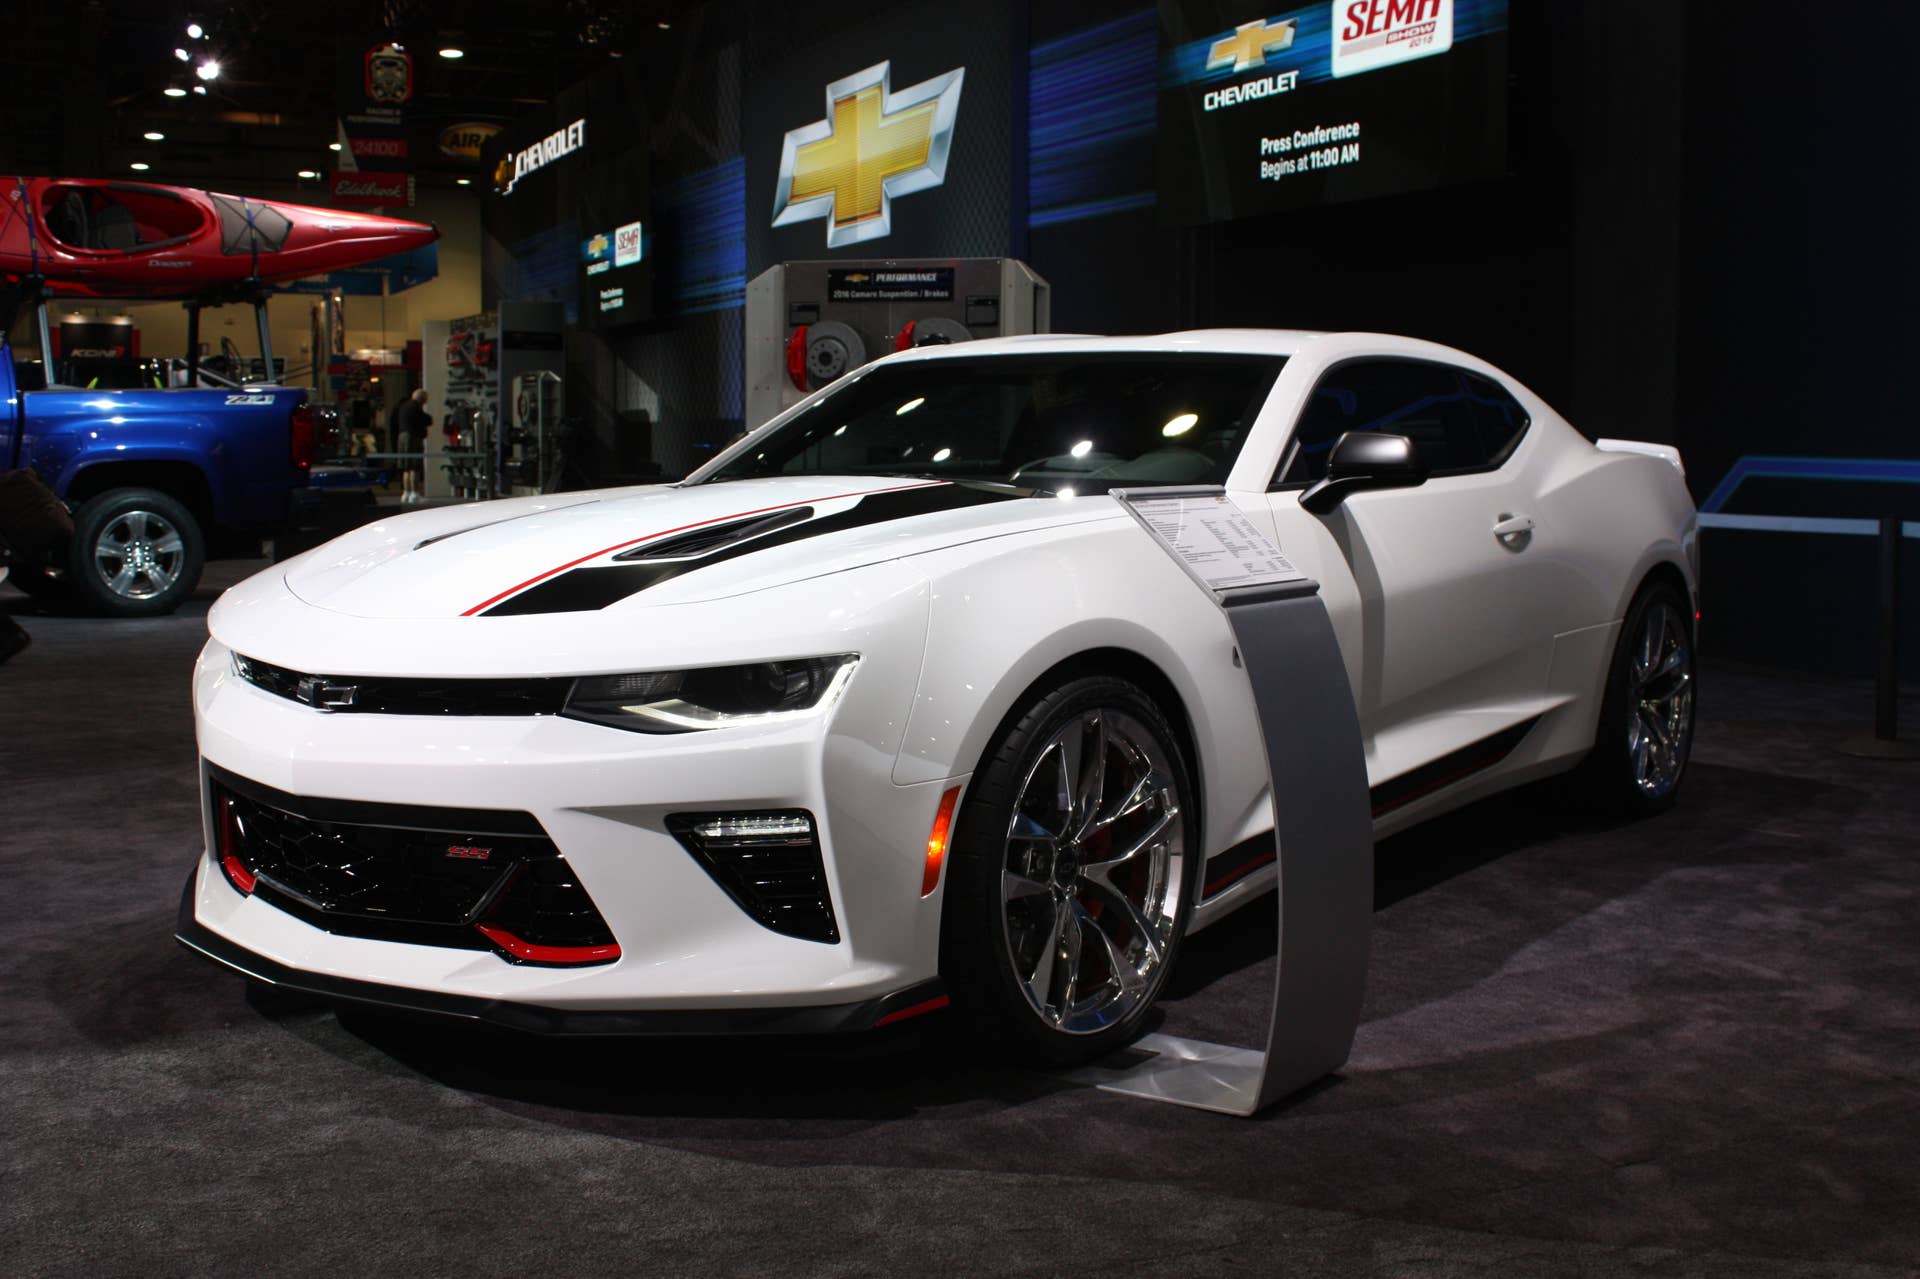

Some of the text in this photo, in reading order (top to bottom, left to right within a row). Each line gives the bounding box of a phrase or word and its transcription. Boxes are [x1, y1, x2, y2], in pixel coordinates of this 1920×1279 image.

[1388, 21, 1436, 43] SHOW
[1204, 70, 1299, 111] CHEVROLET
[517, 118, 586, 178] CHEVROLET
[1261, 122, 1360, 155] Press Conference
[1261, 143, 1360, 181] Begins at 11:00 AM
[875, 272, 938, 283] PERFORMANCE
